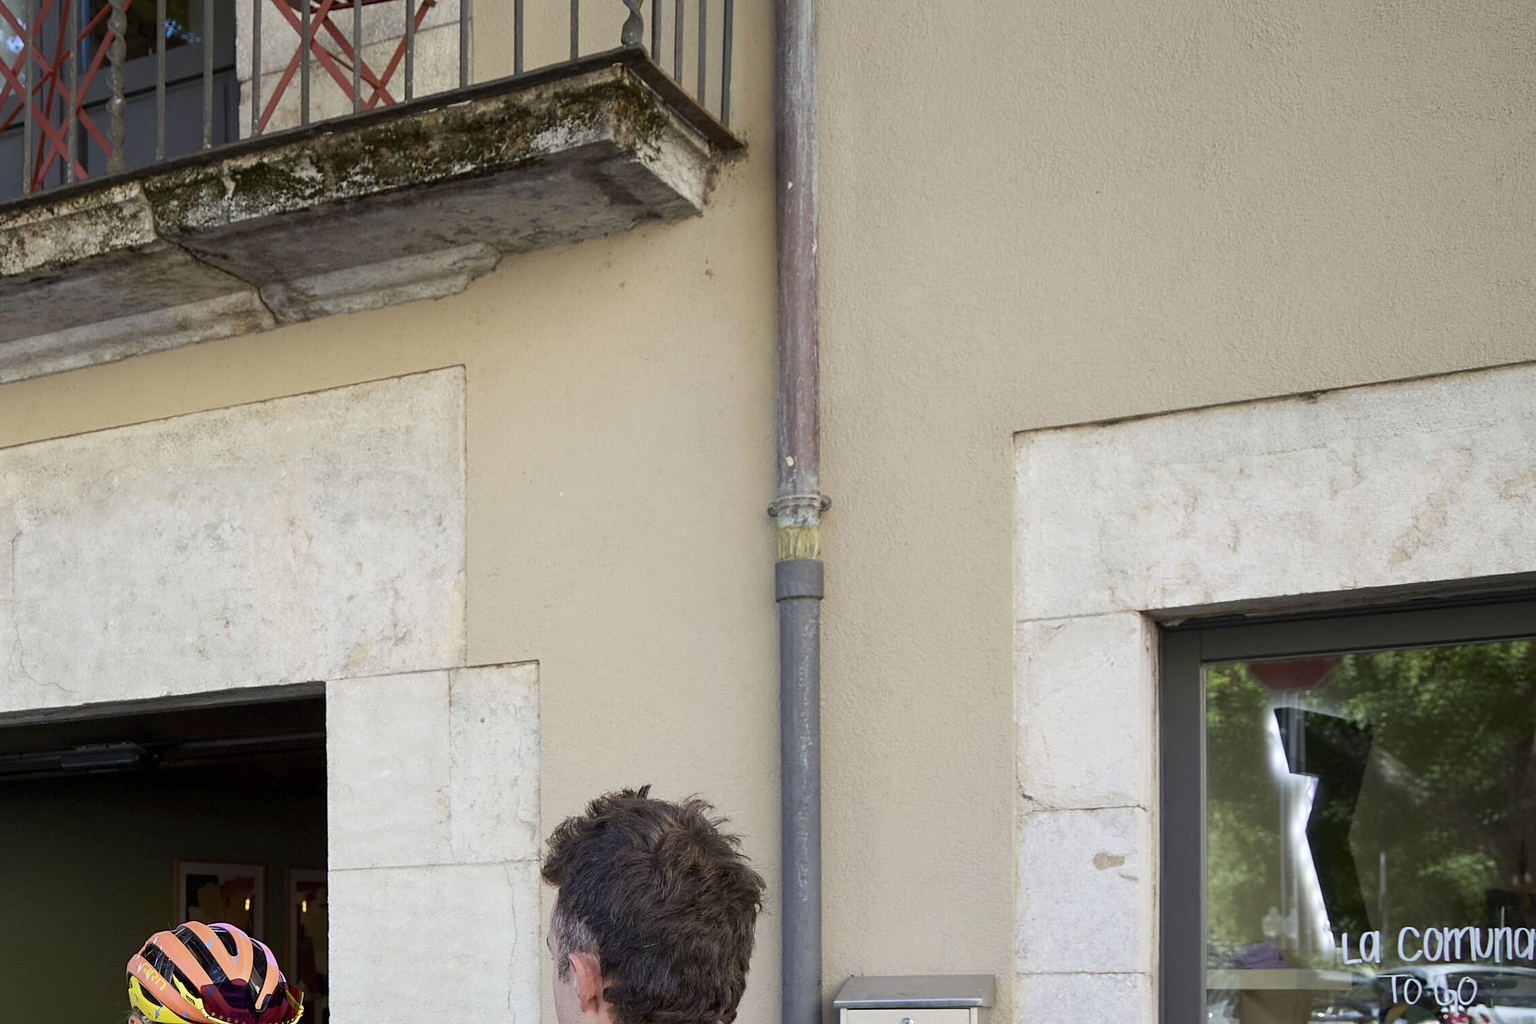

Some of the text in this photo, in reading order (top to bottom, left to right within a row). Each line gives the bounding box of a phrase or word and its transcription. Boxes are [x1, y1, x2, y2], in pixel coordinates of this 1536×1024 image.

[1341, 929, 1382, 965] La
[1375, 973, 1478, 1016] TO GO
